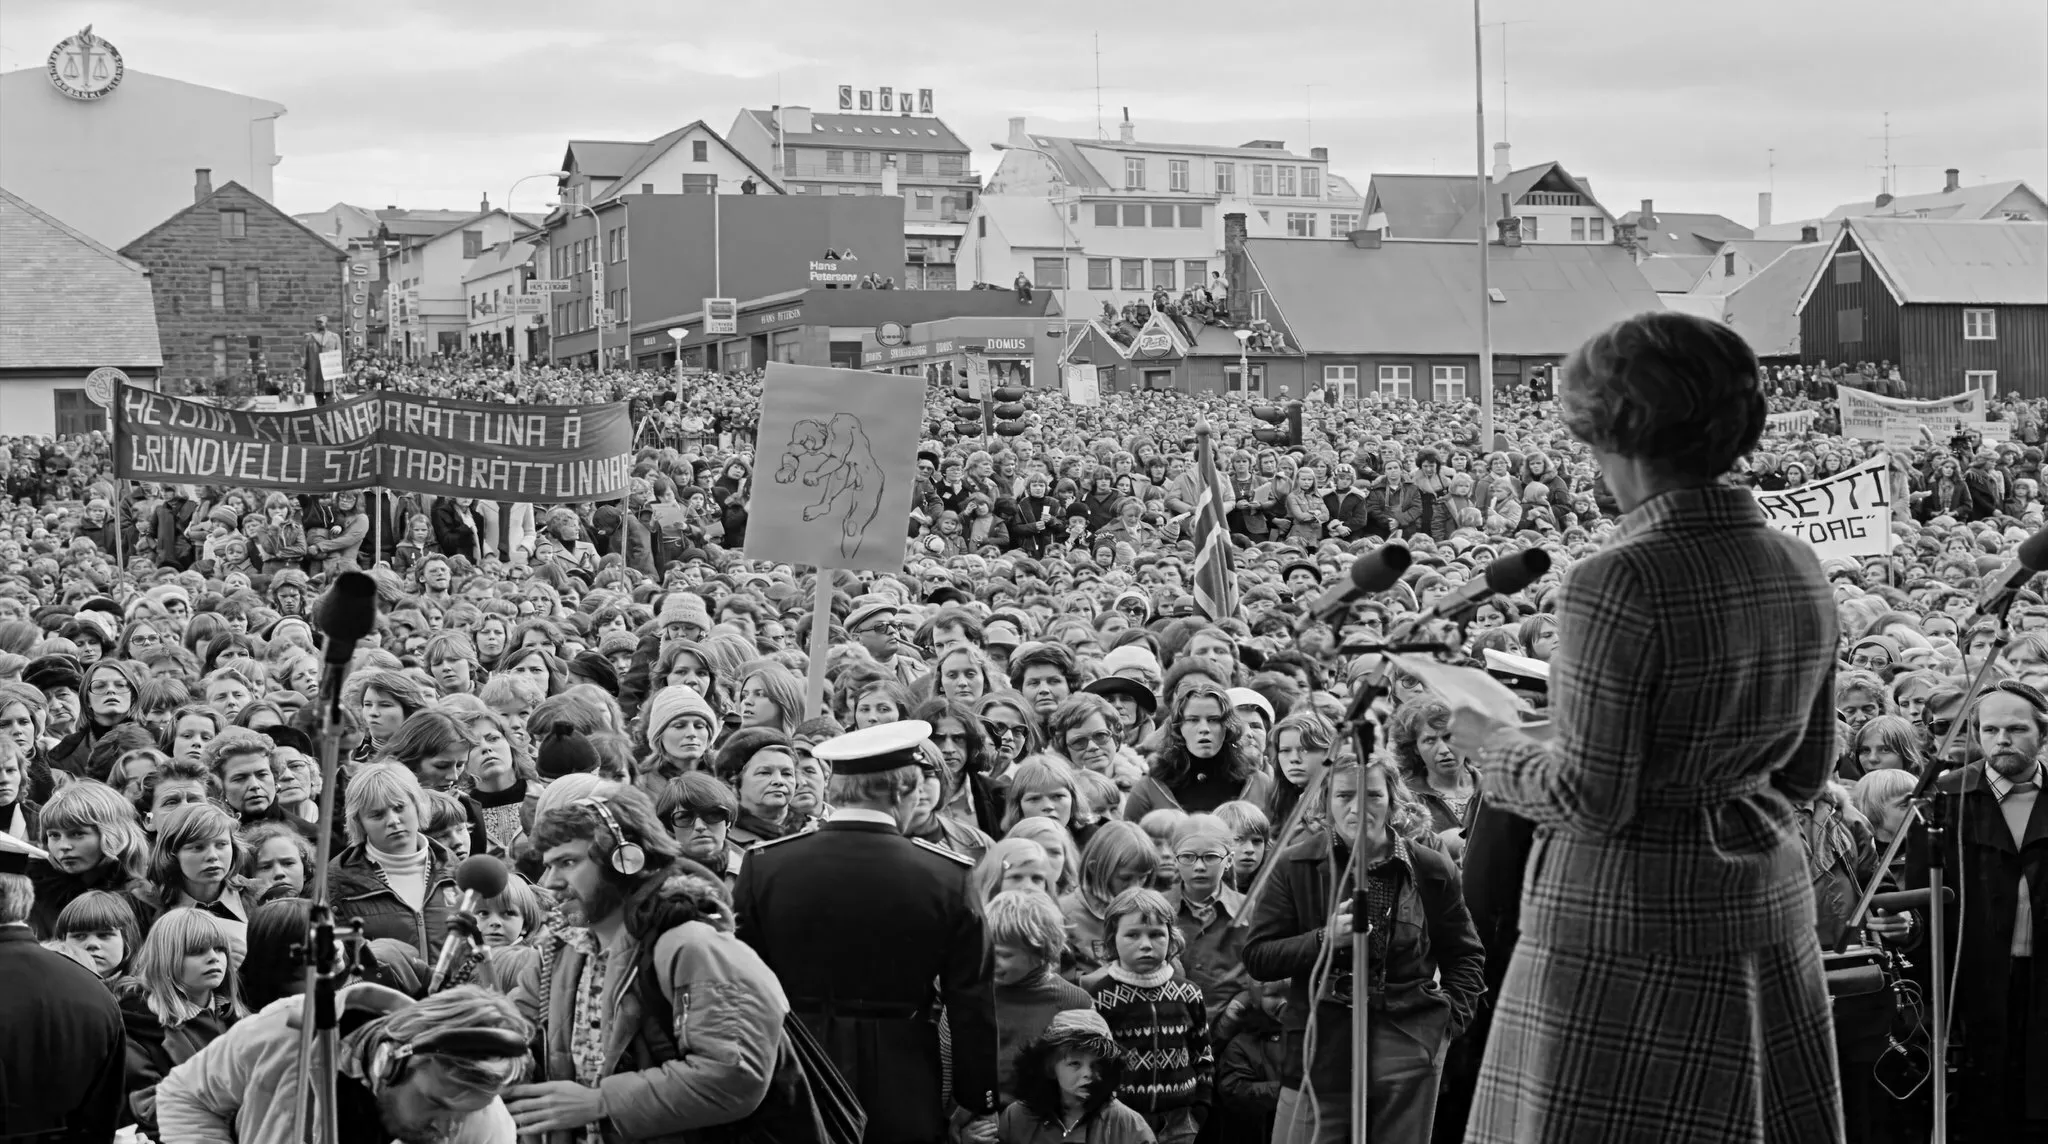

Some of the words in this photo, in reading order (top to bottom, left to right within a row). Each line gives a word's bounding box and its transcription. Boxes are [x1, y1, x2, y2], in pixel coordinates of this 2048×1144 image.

[840, 86, 933, 112] SJÓVÁ
[810, 261, 837, 270] Hans
[351, 263, 368, 346] STELLA
[988, 338, 1025, 350] DOMUS
[125, 389, 236, 434] HEYJUM
[246, 399, 546, 447] KVENNABARÁTTUNA
[562, 408, 581, 449] Á
